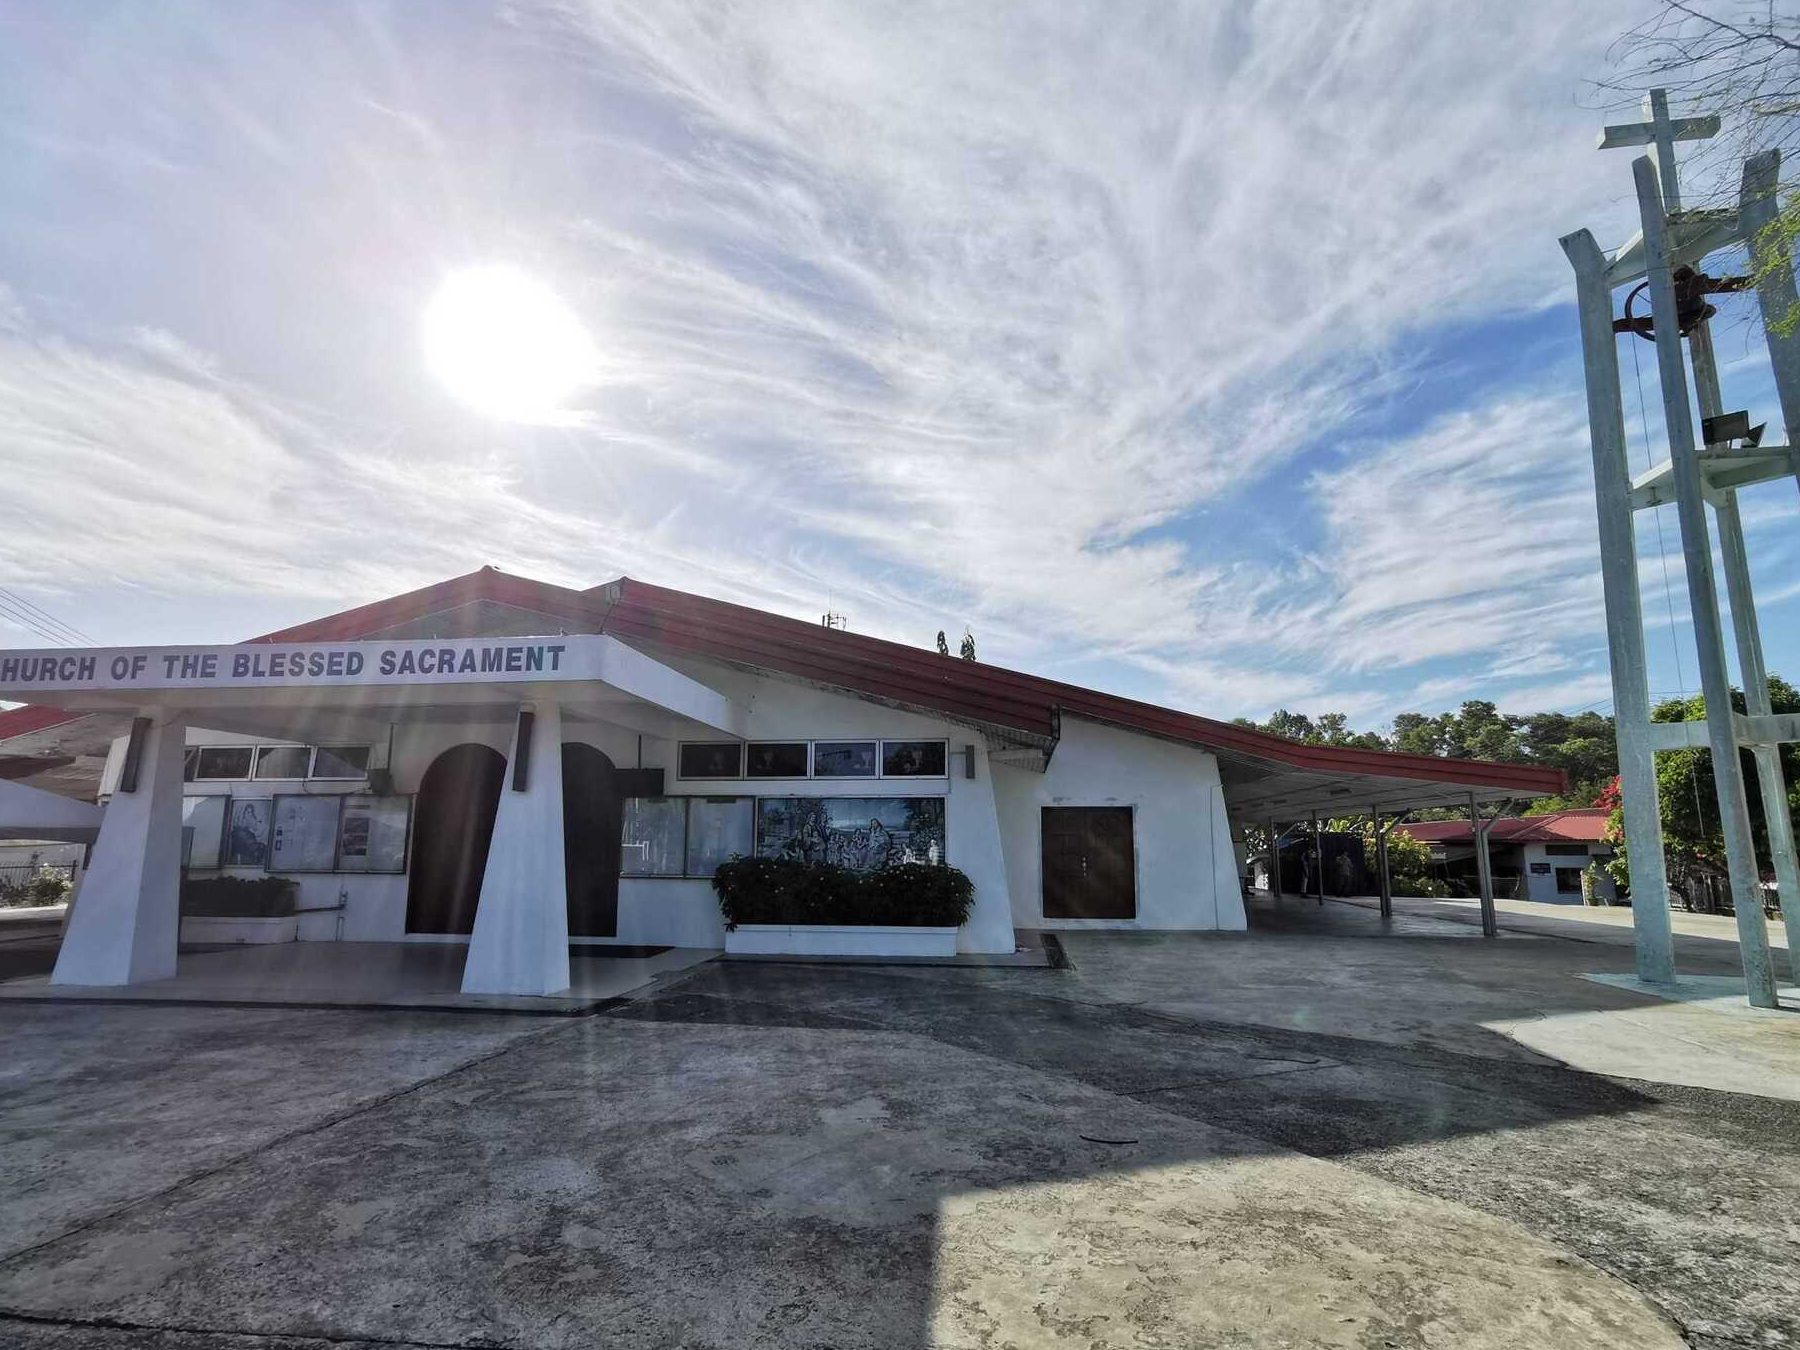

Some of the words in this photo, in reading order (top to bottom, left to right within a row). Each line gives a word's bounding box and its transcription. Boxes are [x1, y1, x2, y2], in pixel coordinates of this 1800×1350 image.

[110, 655, 148, 681] OF
[162, 653, 218, 679] THE
[231, 652, 364, 678] BLESSED
[379, 645, 566, 675] SACRAMENT
